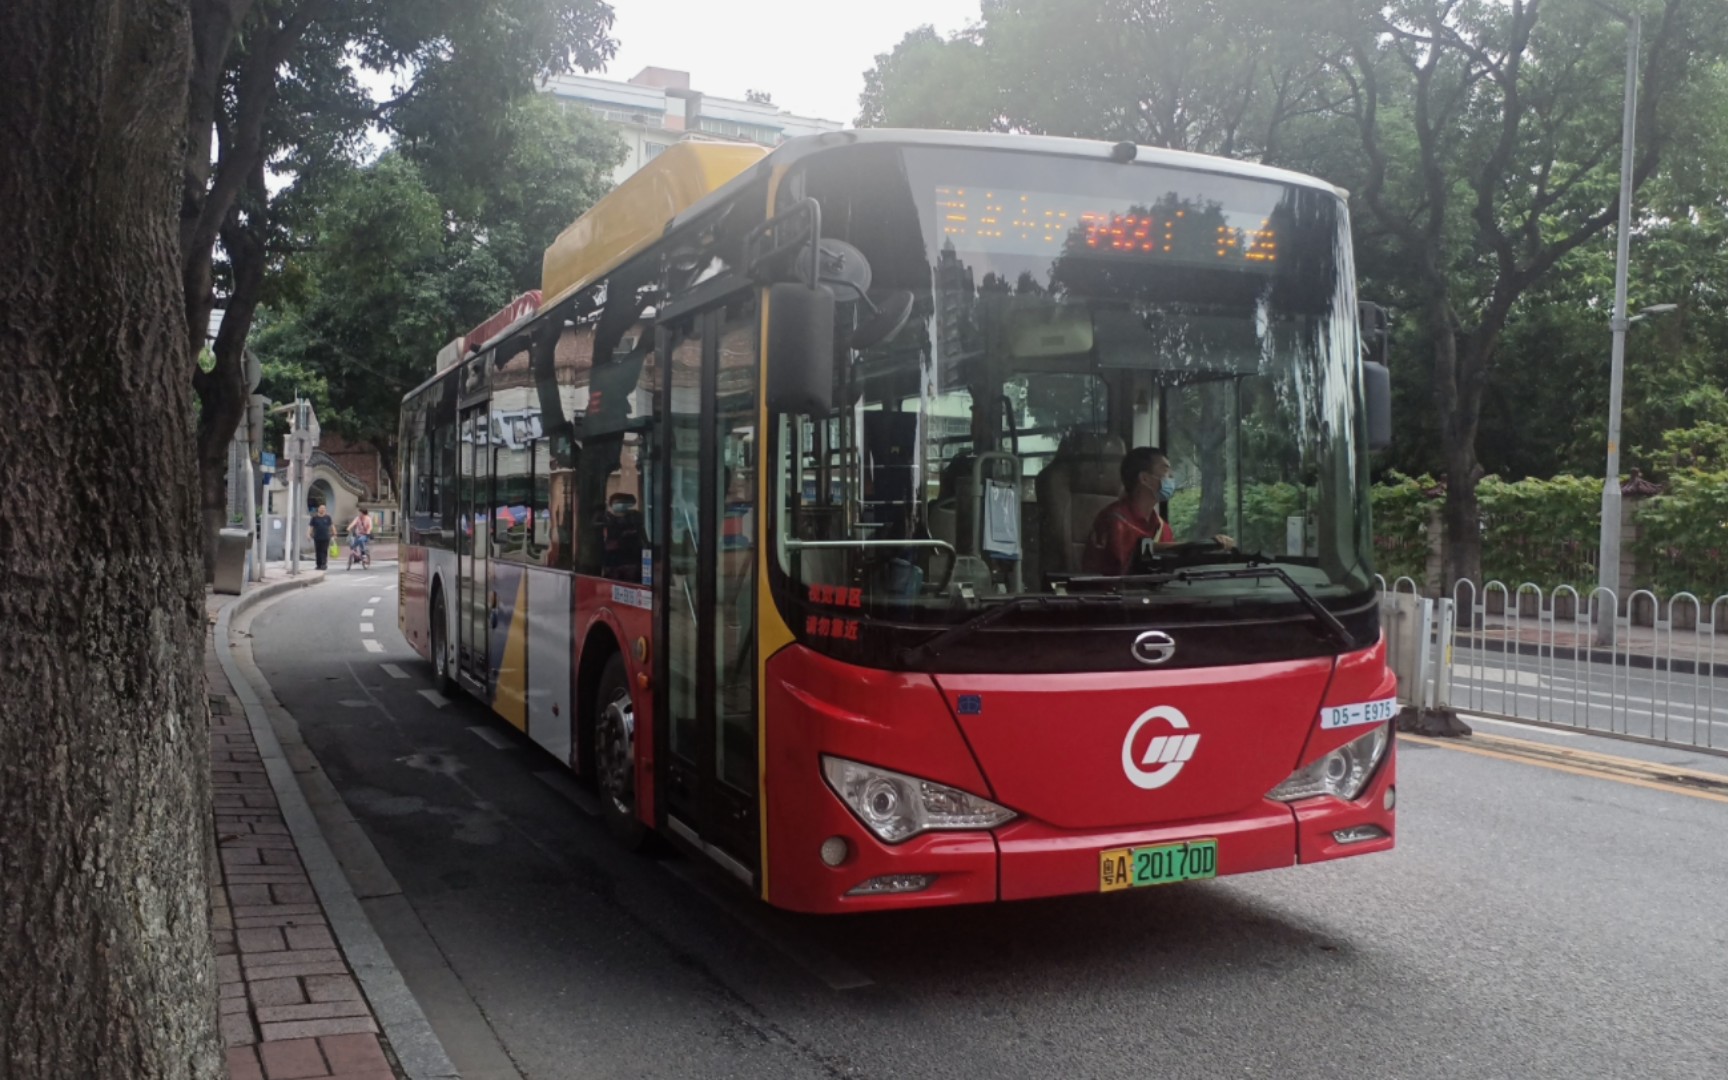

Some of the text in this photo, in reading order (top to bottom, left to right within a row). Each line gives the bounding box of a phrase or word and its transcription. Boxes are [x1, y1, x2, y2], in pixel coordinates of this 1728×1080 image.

[806, 615, 859, 640] 请勿靠近
[1332, 702, 1391, 726] D5-E975
